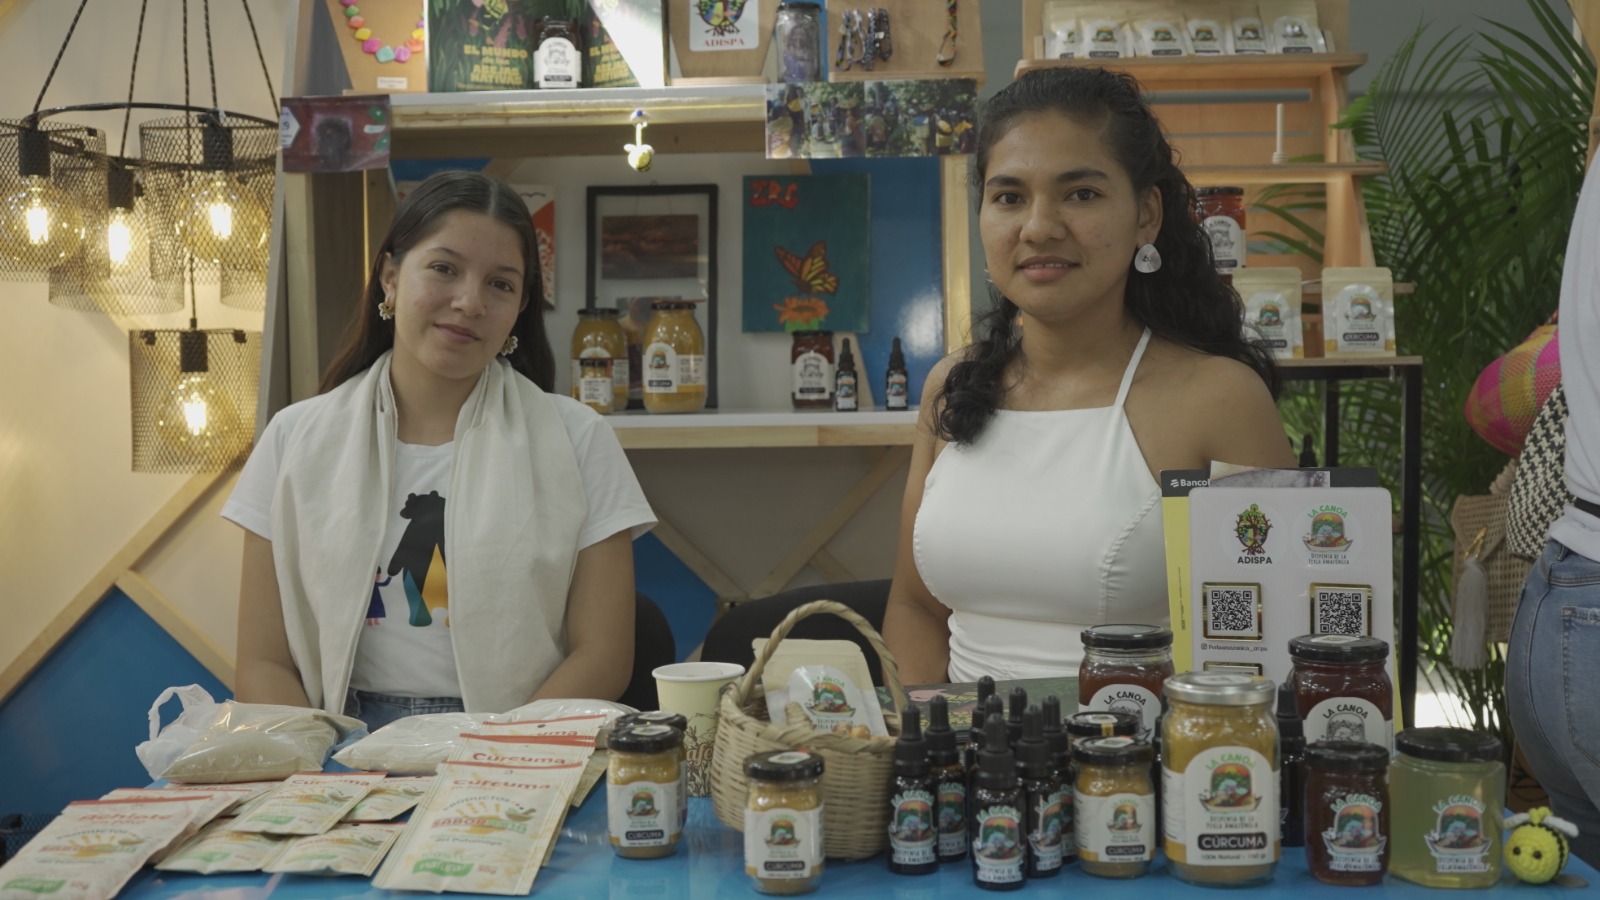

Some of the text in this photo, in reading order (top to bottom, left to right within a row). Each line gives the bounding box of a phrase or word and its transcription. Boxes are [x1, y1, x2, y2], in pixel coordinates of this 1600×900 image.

[463, 44, 528, 59] EL MUNDO
[473, 64, 519, 75] ABEJAS
[470, 73, 523, 85] NATIVAS
[1307, 504, 1348, 518] LA CANOA
[1237, 556, 1273, 565] ADISPA
[1104, 691, 1147, 705] LA CANOA
[1322, 704, 1368, 719] LA CANOA
[686, 741, 715, 767] afé
[1205, 759, 1218, 771] LA
[1201, 834, 1265, 849] CÚRCUMA
